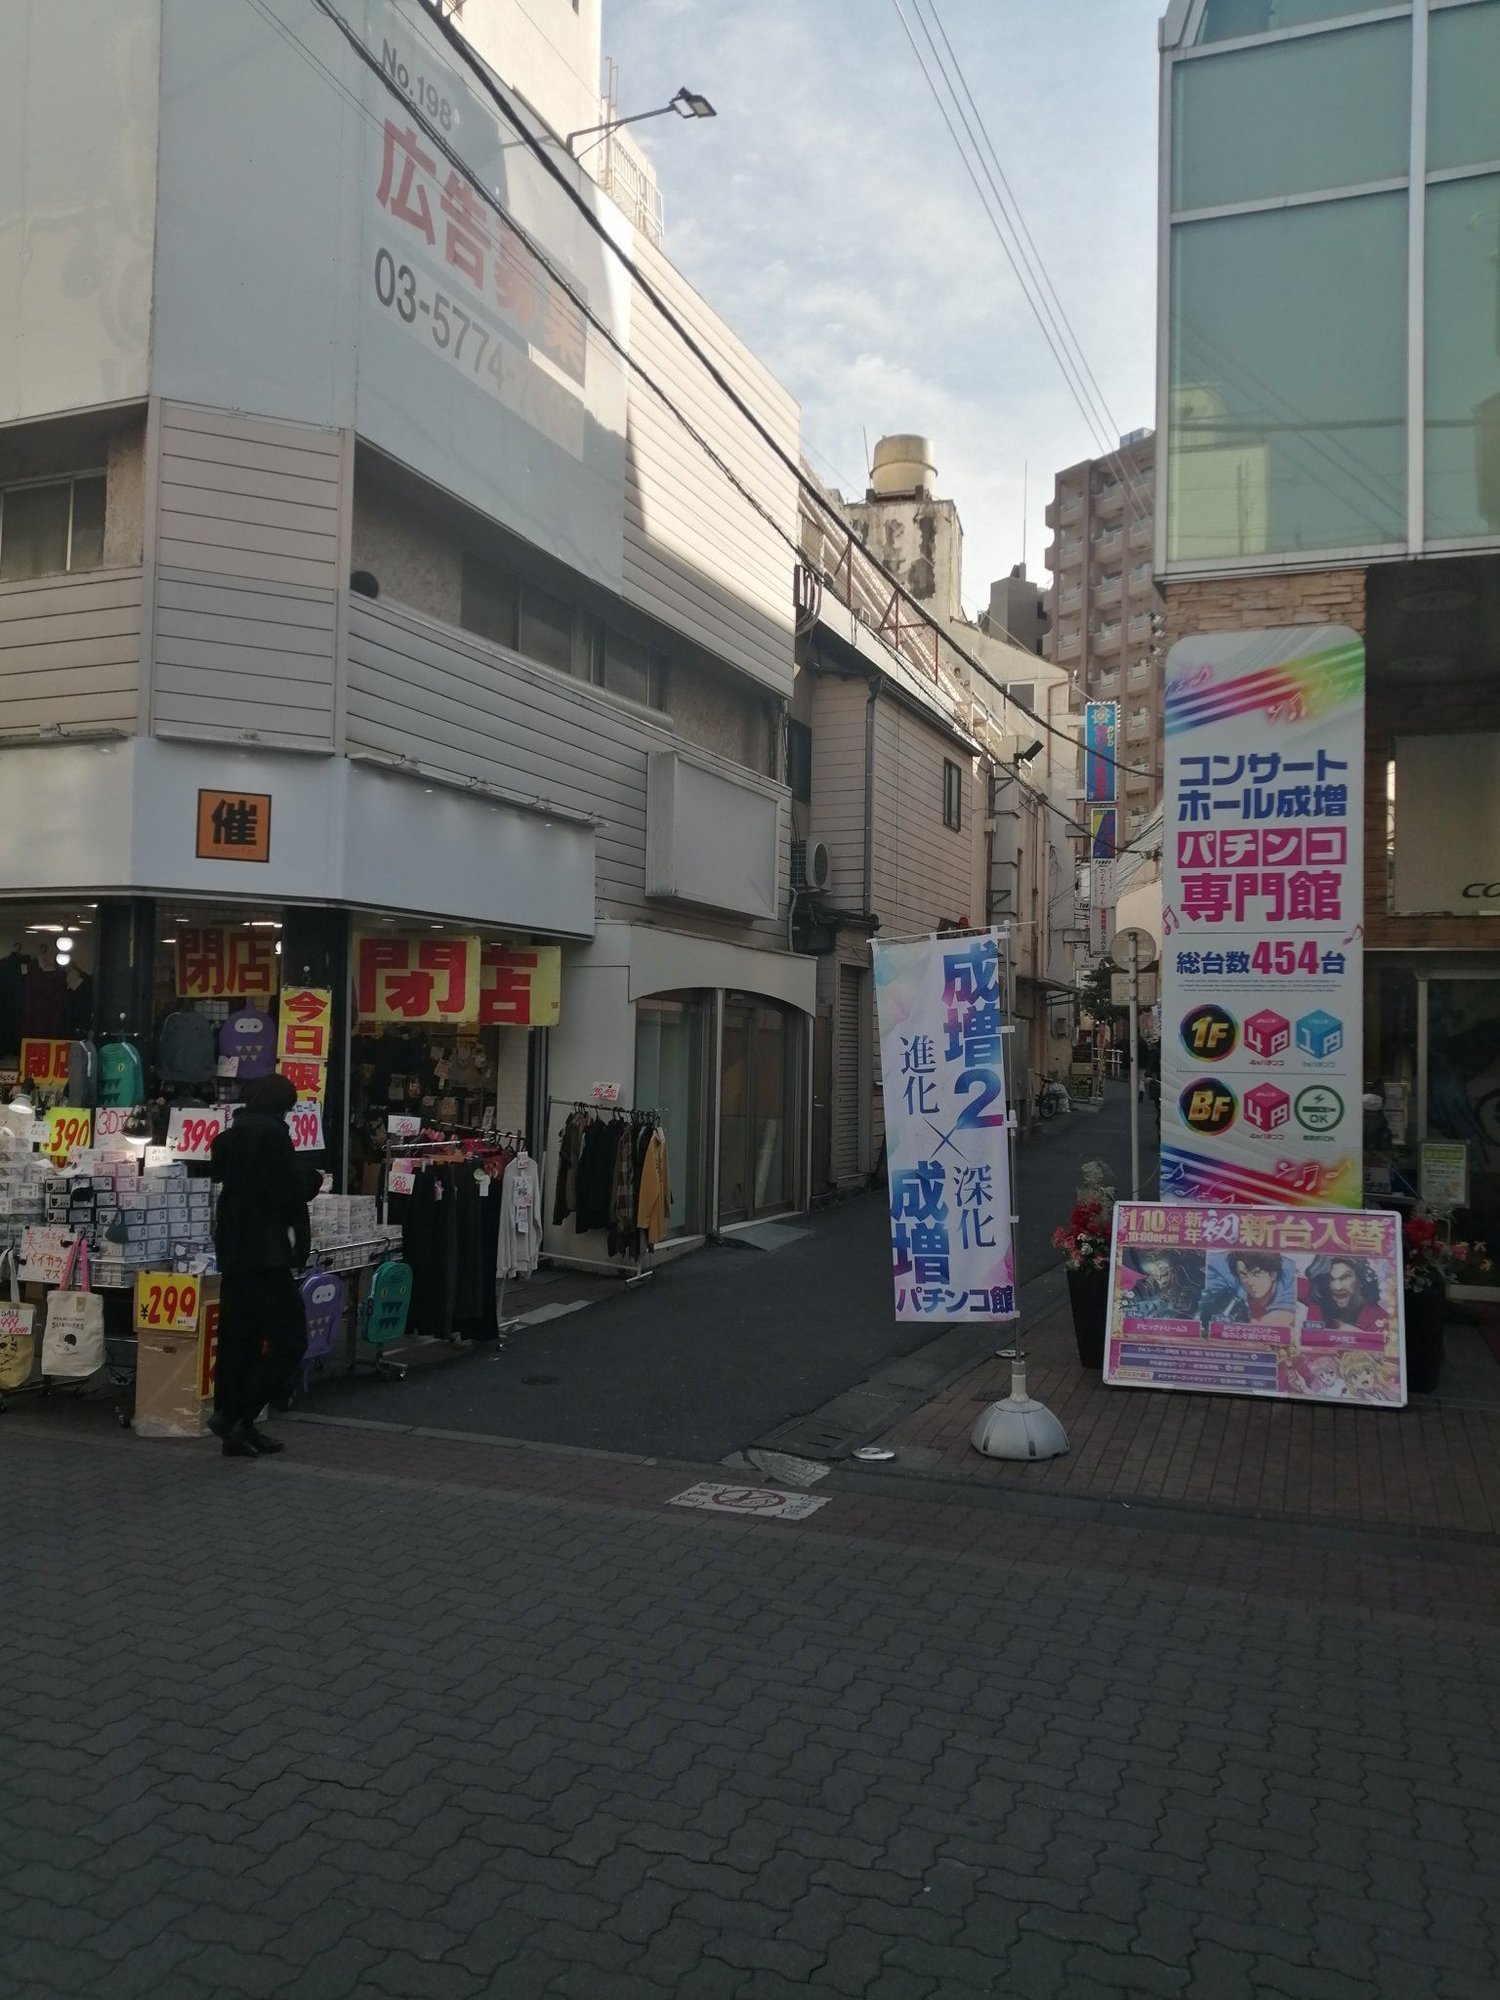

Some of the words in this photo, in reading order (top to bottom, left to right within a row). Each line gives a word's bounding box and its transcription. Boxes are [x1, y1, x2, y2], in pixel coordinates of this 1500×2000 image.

[1180, 750, 1347, 786] コンサート
[1178, 784, 1347, 821] ホール成増
[211, 799, 258, 845] 催
[1179, 829, 1345, 867] パチンコ
[1181, 870, 1341, 922] 専門館
[177, 926, 273, 995] 閉店
[1177, 941, 1346, 975] 総台数454台
[942, 940, 1004, 1130] 成増2
[1192, 1015, 1229, 1048] 1F
[900, 1035, 940, 1115] 進化
[1188, 1091, 1232, 1121] BF
[1310, 1114, 1328, 1123] OK
[891, 1160, 949, 1284] 成増
[953, 1165, 996, 1249] 深化
[140, 1285, 196, 1324] ¥299
[896, 1286, 1013, 1313] パチンコ館
